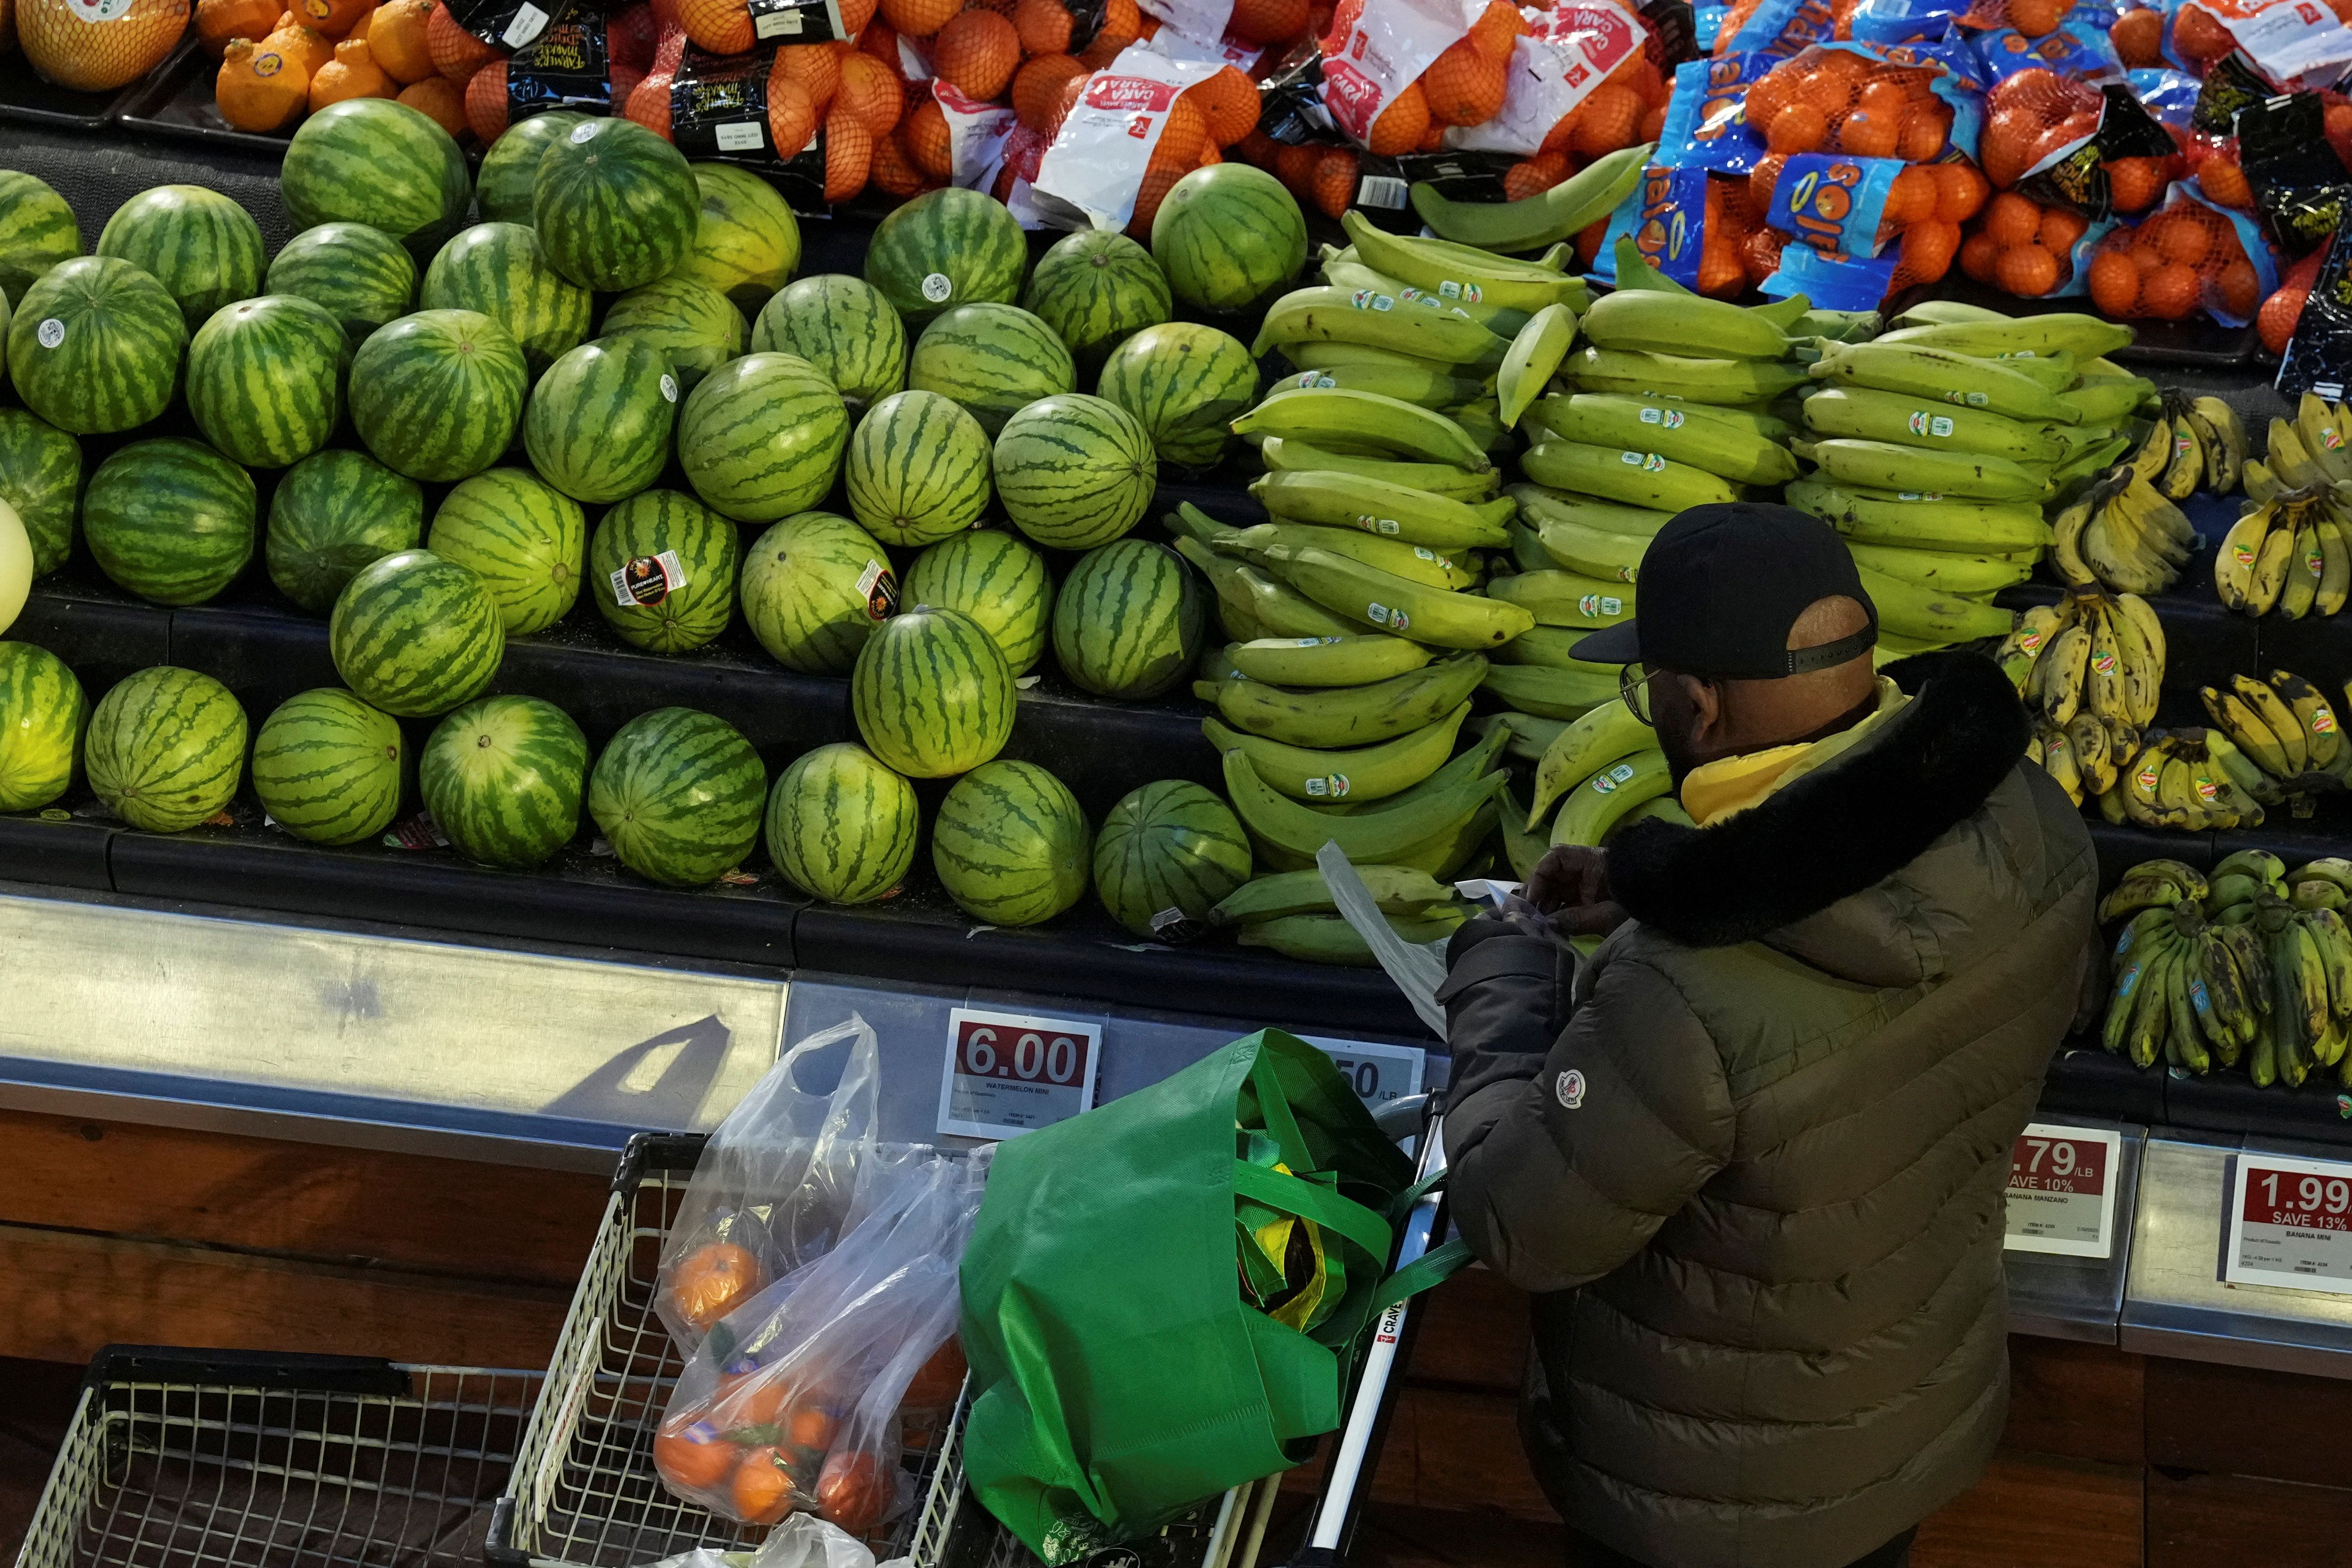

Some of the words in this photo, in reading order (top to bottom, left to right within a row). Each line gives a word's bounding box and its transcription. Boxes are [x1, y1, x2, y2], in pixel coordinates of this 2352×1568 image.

[534, 55, 585, 70] FARMER'S
[1111, 89, 1155, 100] CARA
[1695, 51, 1748, 142] alos
[1636, 166, 1679, 269] alos
[967, 1028, 1077, 1083] 6.00
[986, 1083, 1034, 1094] WATERMELON
[2013, 1139, 2076, 1176] .79
[2074, 1167, 2094, 1177] /LB
[2009, 1175, 2039, 1189] AVE
[2044, 1178, 2074, 1193] 10%
[2261, 1173, 2350, 1214] 1.99
[2004, 1192, 2032, 1201] BANANA
[2034, 1195, 2068, 1203] MANZANO
[2272, 1211, 2311, 1227] SAVE
[2317, 1215, 2347, 1231] 13%
[2286, 1230, 2315, 1240] BANANA
[1383, 1303, 1403, 1334] CRAVE
